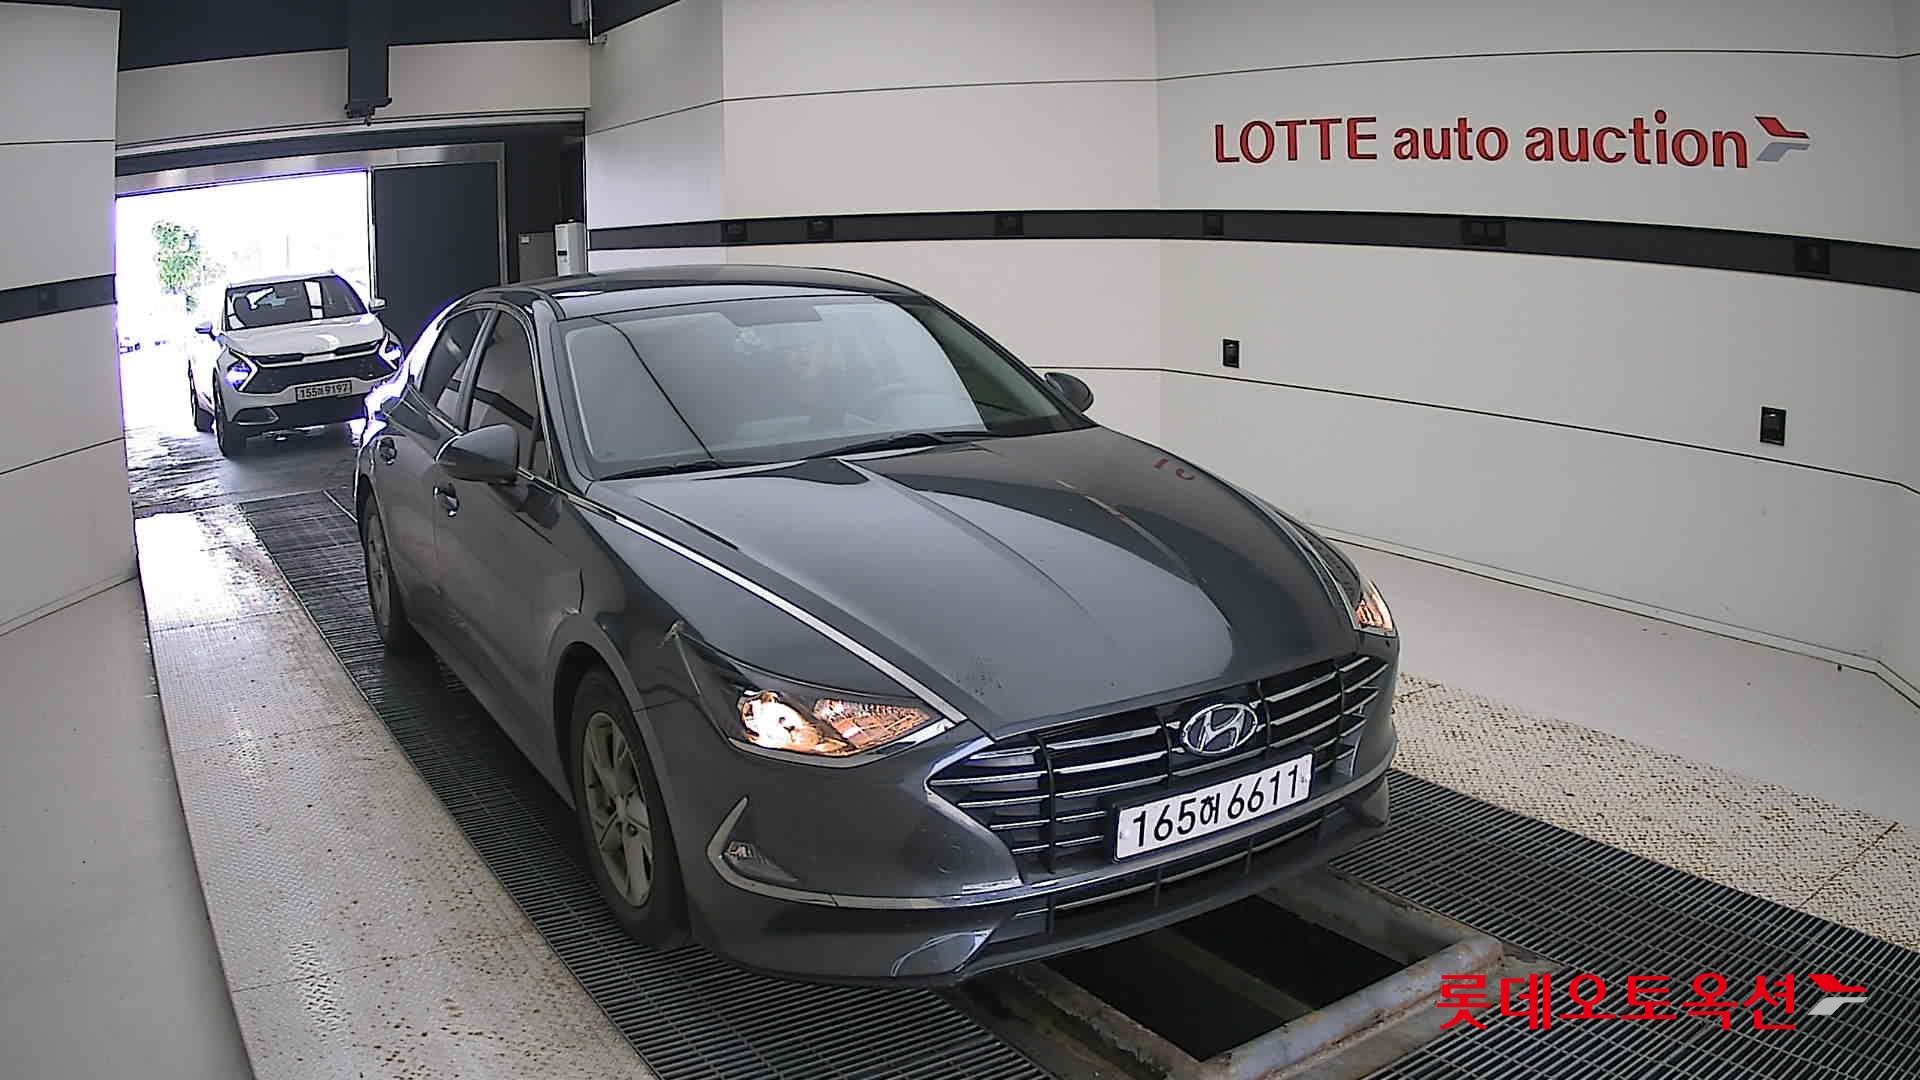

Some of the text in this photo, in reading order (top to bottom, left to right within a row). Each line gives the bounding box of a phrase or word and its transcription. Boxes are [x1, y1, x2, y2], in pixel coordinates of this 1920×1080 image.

[1215, 110, 1748, 169] LOTTE auto auction
[1133, 764, 1298, 847] 165허6611
